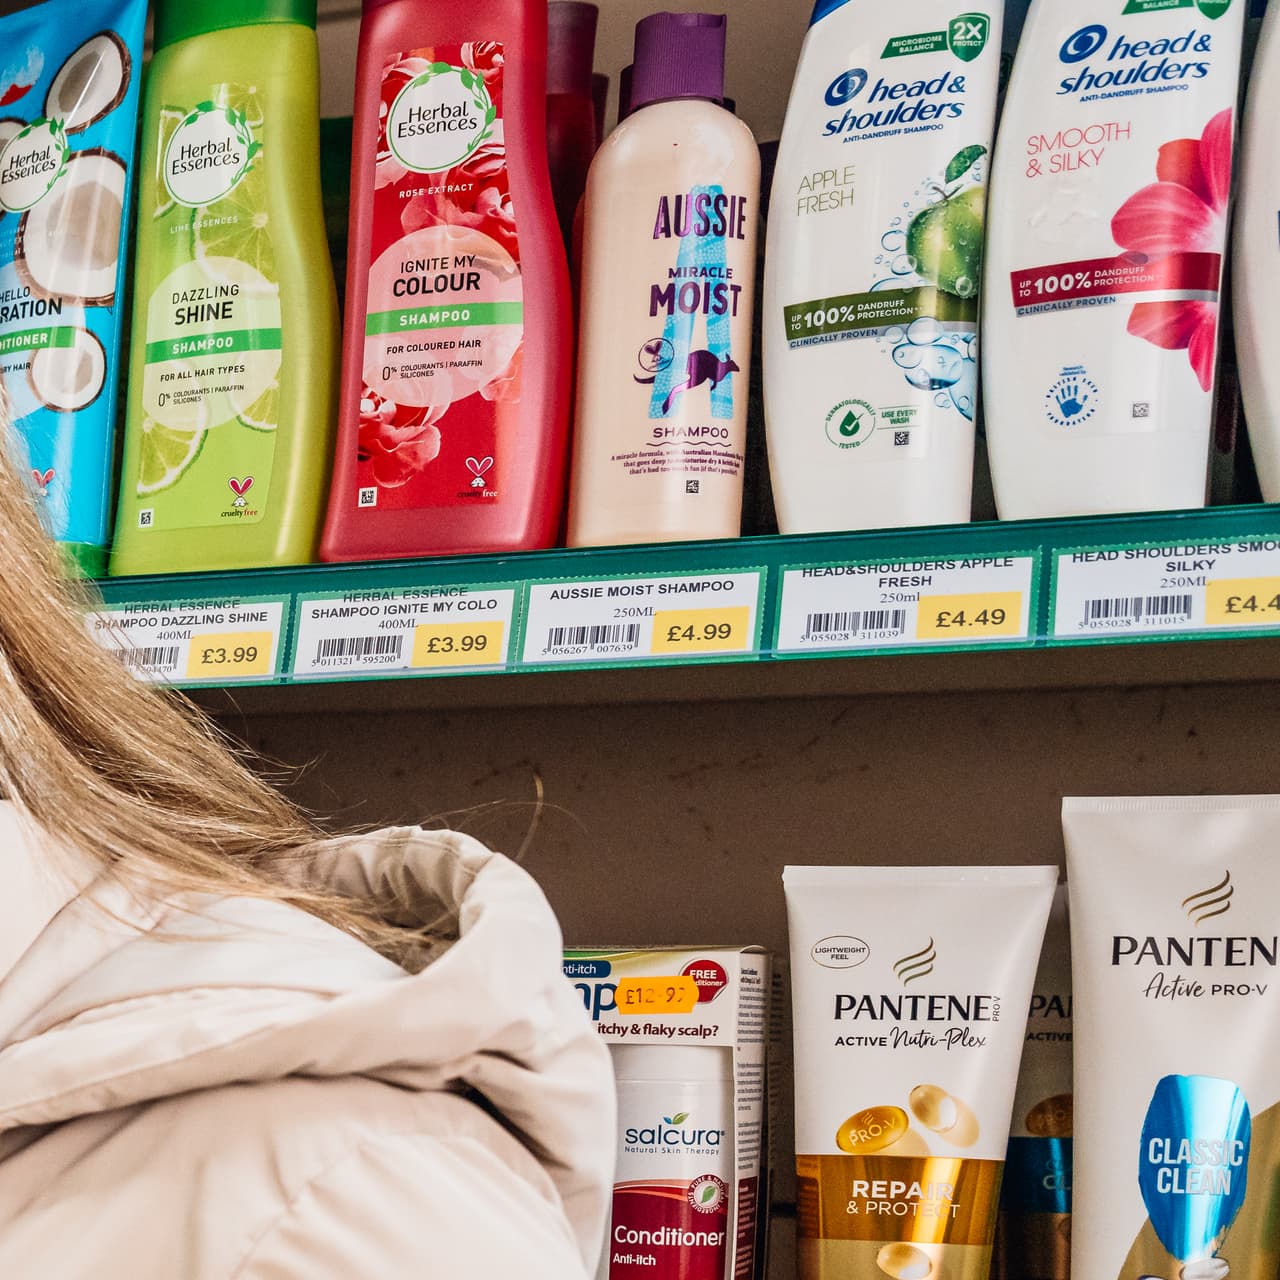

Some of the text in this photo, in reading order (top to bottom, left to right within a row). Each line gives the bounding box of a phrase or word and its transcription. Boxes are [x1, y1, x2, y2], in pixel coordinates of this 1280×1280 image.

[953, 21, 983, 40] 2X
[1107, 29, 1212, 61] head &
[1056, 57, 1211, 95] shoulders
[867, 71, 966, 104] head &
[1079, 84, 1189, 103] ANTI-DANDRUFF SHAMPOO
[408, 101, 469, 124] Herbal
[822, 99, 965, 137] shoulders
[398, 117, 478, 139] Essences
[842, 123, 944, 144] ANTI-DANDRUFF SHAMPOO
[1026, 121, 1131, 156] SMOOTH
[9, 146, 51, 169] Herbal
[180, 137, 232, 161] Herbal
[1, 158, 56, 184] Essences
[172, 152, 240, 175] Essences
[1025, 147, 1105, 179] & SILKY
[797, 165, 856, 195] APPLE
[399, 183, 474, 199] ROSE EXTRACT
[797, 189, 854, 217] FRESH
[652, 193, 747, 240] AUSSIE
[400, 255, 476, 274] IGNITE MY
[668, 266, 733, 279] MIRACLE
[1093, 265, 1145, 278] DANDRUFF
[393, 272, 481, 298] COLOUR
[1034, 271, 1092, 295] 100%
[172, 284, 240, 304] DAZZLING
[649, 281, 742, 317] MOIST
[175, 301, 233, 326] SHINE
[857, 300, 905, 312] DANDRUFF
[1018, 296, 1116, 316] CLINICALLY PROVEN
[399, 309, 471, 326] SHAMPOO
[804, 305, 856, 328] 100%
[172, 336, 233, 355] SHAMPOO
[386, 339, 482, 355] FOR COLOURED HAIR
[790, 329, 878, 349] CLINICALLY PROVEN
[653, 426, 729, 439] SHAMPOO
[1072, 540, 1280, 563] HEAD SHOULDERS SMO
[802, 556, 1013, 578] HEAD&SHOULDERS APPLE
[1166, 559, 1216, 573] SILKY
[550, 580, 734, 600] AUSSIE MOIST SHAMPOO
[878, 576, 932, 588] FRESH
[1160, 576, 1211, 589] 250ML
[343, 586, 469, 604] HERBAL ESSENCE
[880, 592, 920, 604] 250ml
[124, 600, 241, 615] HERBAL ESSENCE
[311, 598, 498, 619] SHAMPOO IGNITE MY COLO
[613, 606, 657, 618] 250ML
[95, 611, 268, 630] SHAMPOO DAZZLING SHINE
[378, 618, 420, 630] 400ML
[935, 608, 1006, 628] £4.49
[666, 623, 732, 643] £4.99
[427, 634, 488, 654] £3.99
[201, 646, 258, 665] £3.99
[690, 969, 717, 979] FREE
[1142, 971, 1206, 1000] Active
[834, 994, 991, 1022] PANTENE
[597, 1023, 719, 1039] itchy & flaky scalp?
[835, 1026, 986, 1051] ACTIVE Nutri-Plex
[625, 1124, 722, 1146] salcura
[625, 1146, 720, 1155] Natural Skin Therapy
[1148, 1137, 1244, 1166] CLASSIC
[852, 1180, 954, 1201] REPAIR
[1156, 1167, 1232, 1196] CLEAN
[846, 1201, 960, 1218] & PROTECT
[614, 1225, 724, 1246] Conditioner
[613, 1253, 656, 1266] Anti-itch
